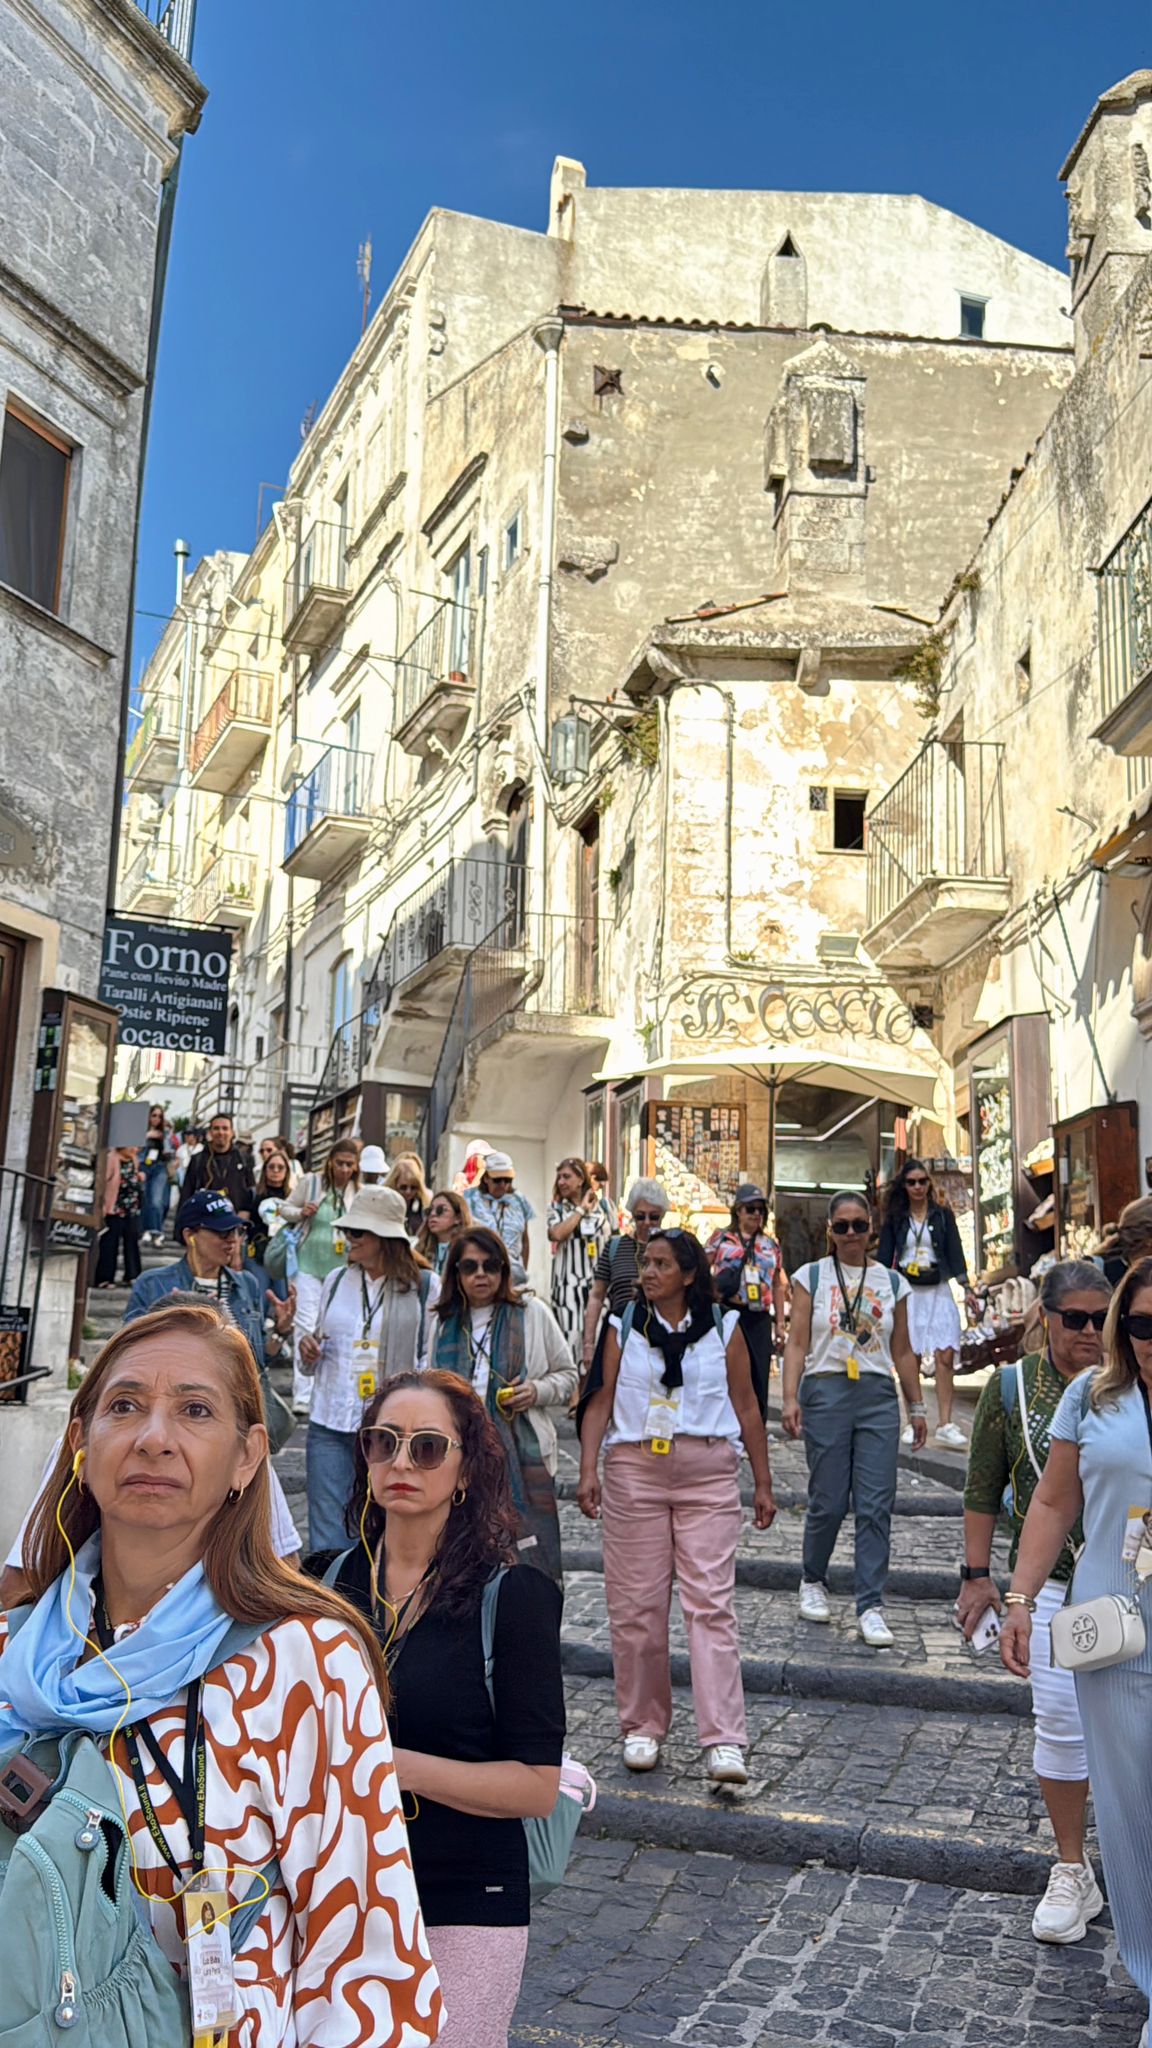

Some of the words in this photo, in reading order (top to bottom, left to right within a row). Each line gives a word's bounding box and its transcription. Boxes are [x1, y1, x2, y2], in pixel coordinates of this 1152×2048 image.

[104, 928, 227, 978] Forno
[102, 966, 129, 980] Pane
[130, 972, 152, 983] con
[154, 972, 190, 987] lievito
[192, 978, 227, 992] Madre
[103, 984, 147, 1002] Taralli
[150, 990, 223, 1011] Artigianali
[114, 1003, 152, 1022] Ostie
[156, 1008, 210, 1027] Ripiene
[118, 1021, 215, 1053] ocaccia
[197, 1745, 205, 1827] www.EkoSound.it
[138, 1784, 172, 1861] www.EkoSound.it
